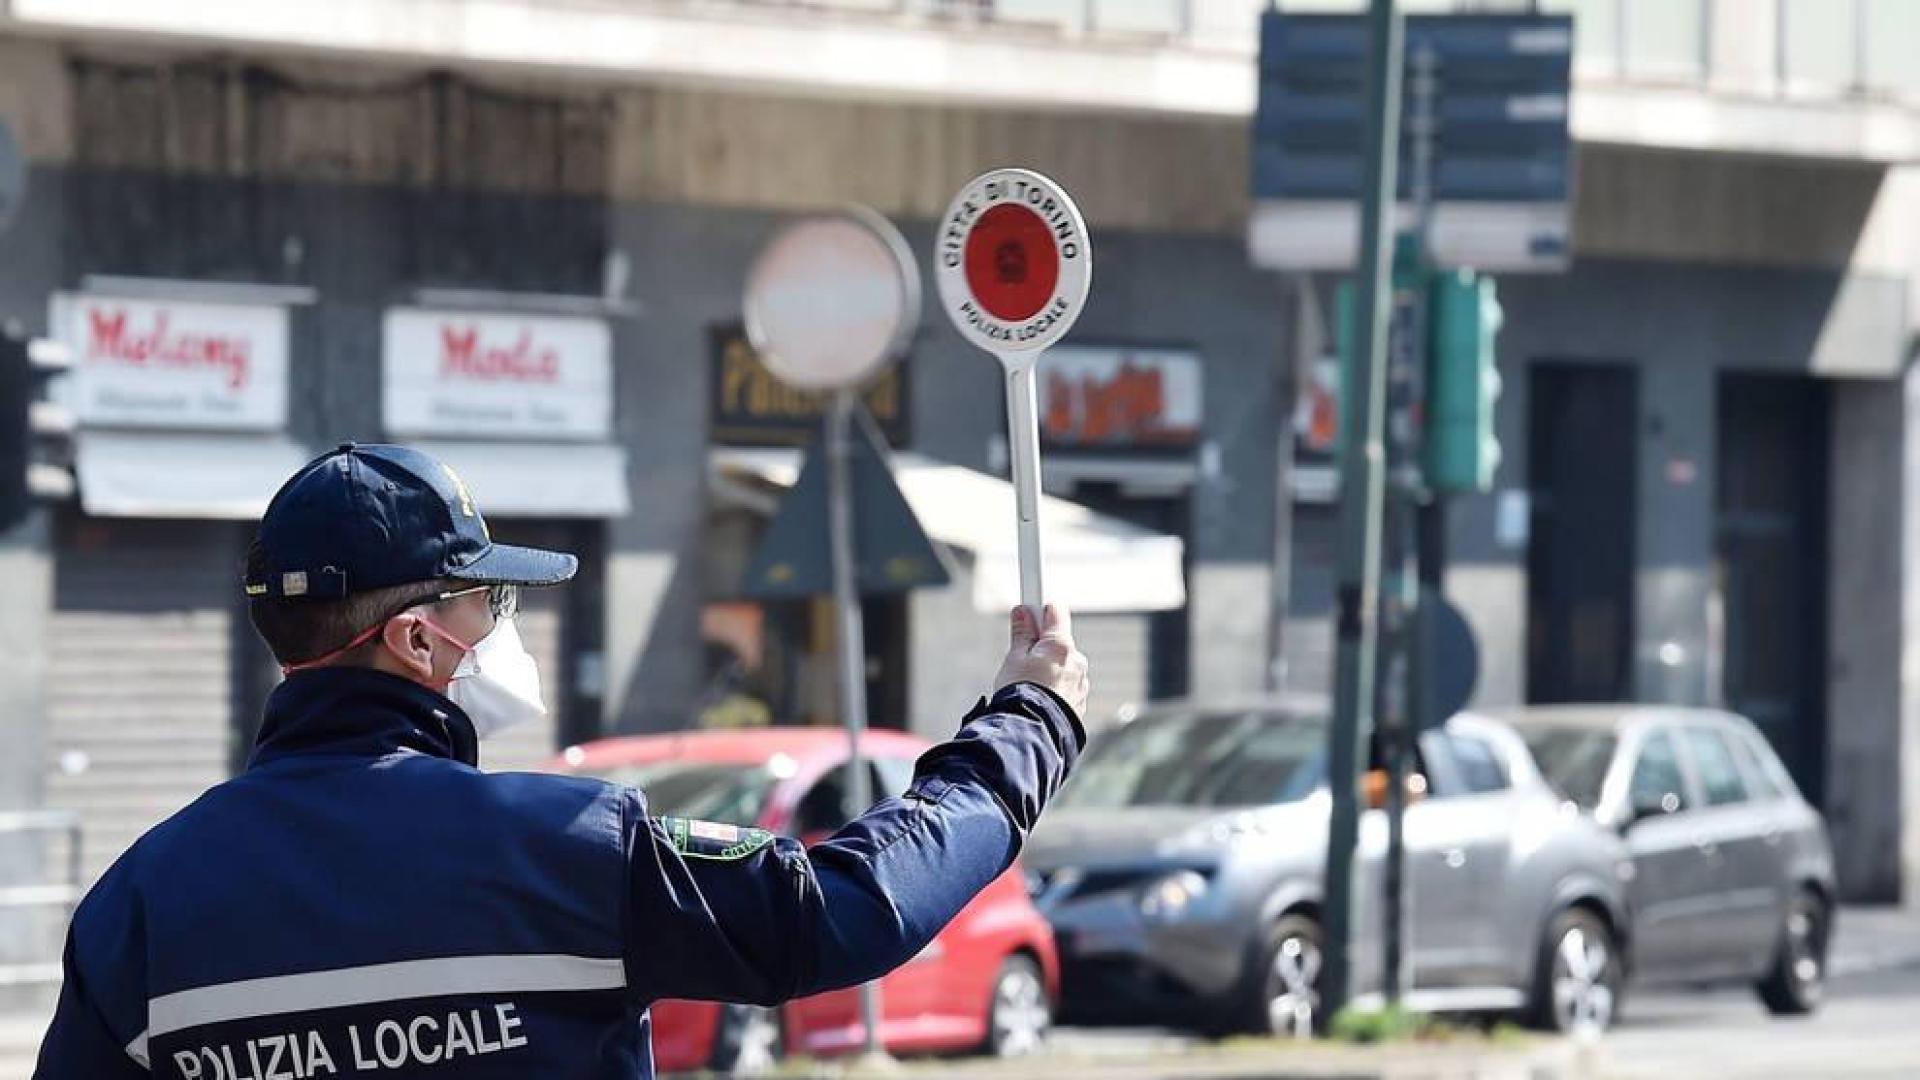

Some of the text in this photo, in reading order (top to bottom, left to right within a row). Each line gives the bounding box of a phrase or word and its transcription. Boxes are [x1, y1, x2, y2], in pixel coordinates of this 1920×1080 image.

[985, 180, 1009, 201] DI
[1016, 181, 1078, 259] TORINO
[960, 296, 1068, 342] POLIZIA LOCALE
[173, 1002, 528, 1080] POLIZIA LOCALE
